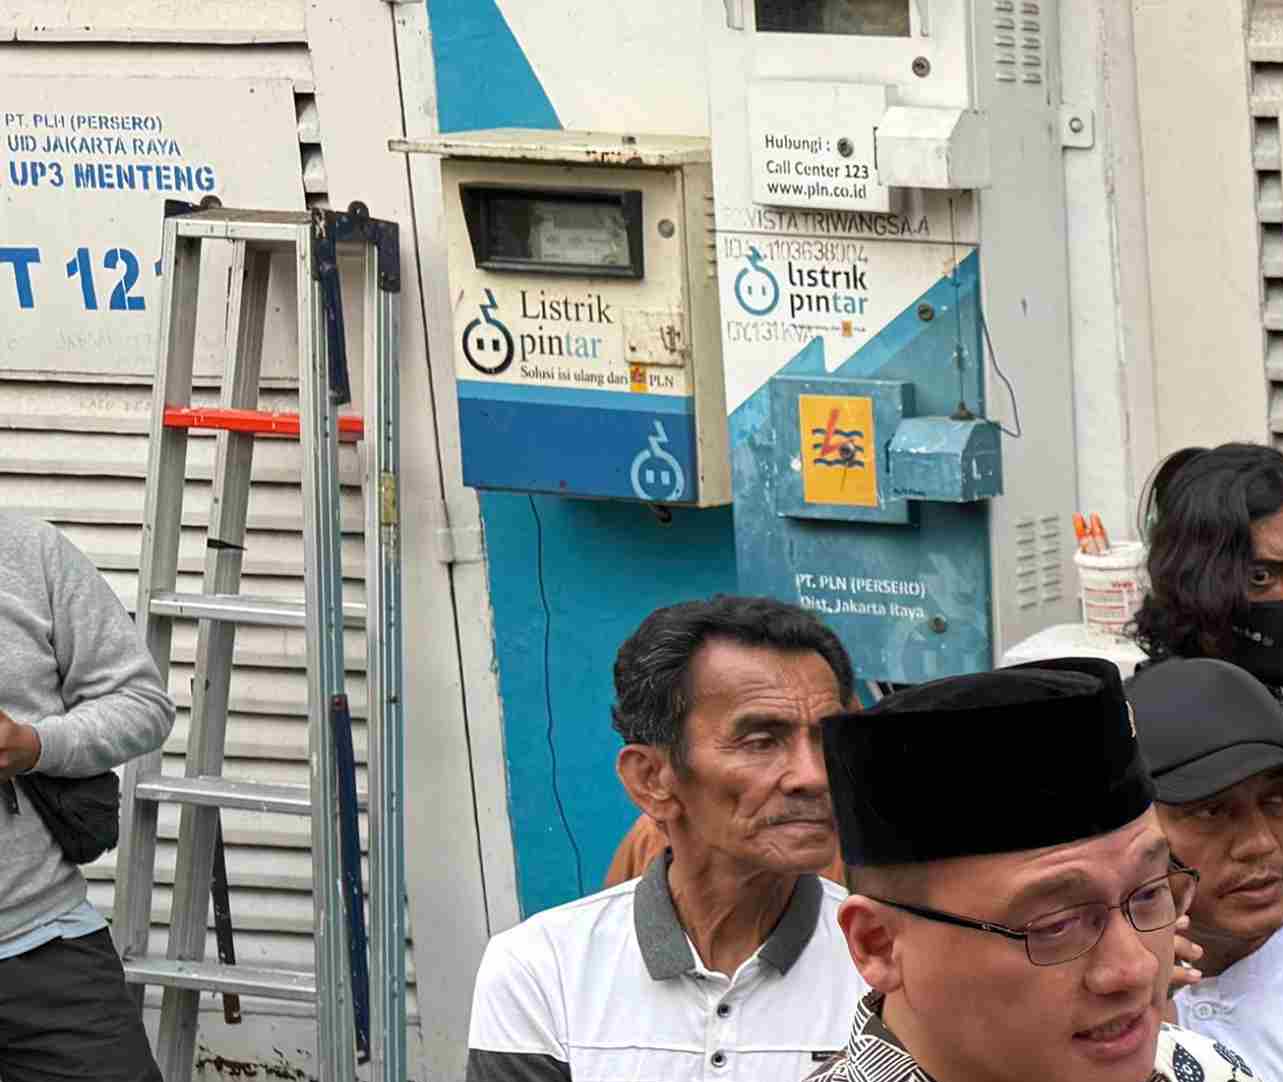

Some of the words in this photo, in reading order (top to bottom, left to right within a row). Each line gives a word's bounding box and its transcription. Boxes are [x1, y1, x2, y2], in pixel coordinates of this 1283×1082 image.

[33, 114, 65, 129] PLN
[70, 115, 163, 133] (PERSERO)
[7, 134, 37, 153] UID
[42, 136, 127, 156] JAKARTA
[133, 137, 182, 157] RAYA
[764, 134, 823, 153] Hubungi
[9, 160, 65, 187] UP3
[73, 162, 216, 191] MENTENG
[766, 160, 790, 174] Call
[795, 161, 840, 178] Center
[845, 165, 870, 179] 123
[767, 181, 867, 199] www.pln.co.id
[0, 247, 41, 309] T
[66, 247, 162, 310] 12
[788, 261, 868, 290] listrik
[521, 289, 614, 324] Listrik
[790, 292, 869, 318] pintar
[520, 326, 603, 362] pintar
[520, 366, 556, 381] Solusi
[558, 367, 571, 381] isi
[574, 369, 604, 386] ulang
[649, 375, 675, 388] PLN
[795, 573, 817, 589] PT.
[820, 575, 847, 591] PLN
[850, 577, 926, 599] (PERSERO)
[827, 597, 888, 615] Jakarta
[890, 601, 924, 619] Raya
